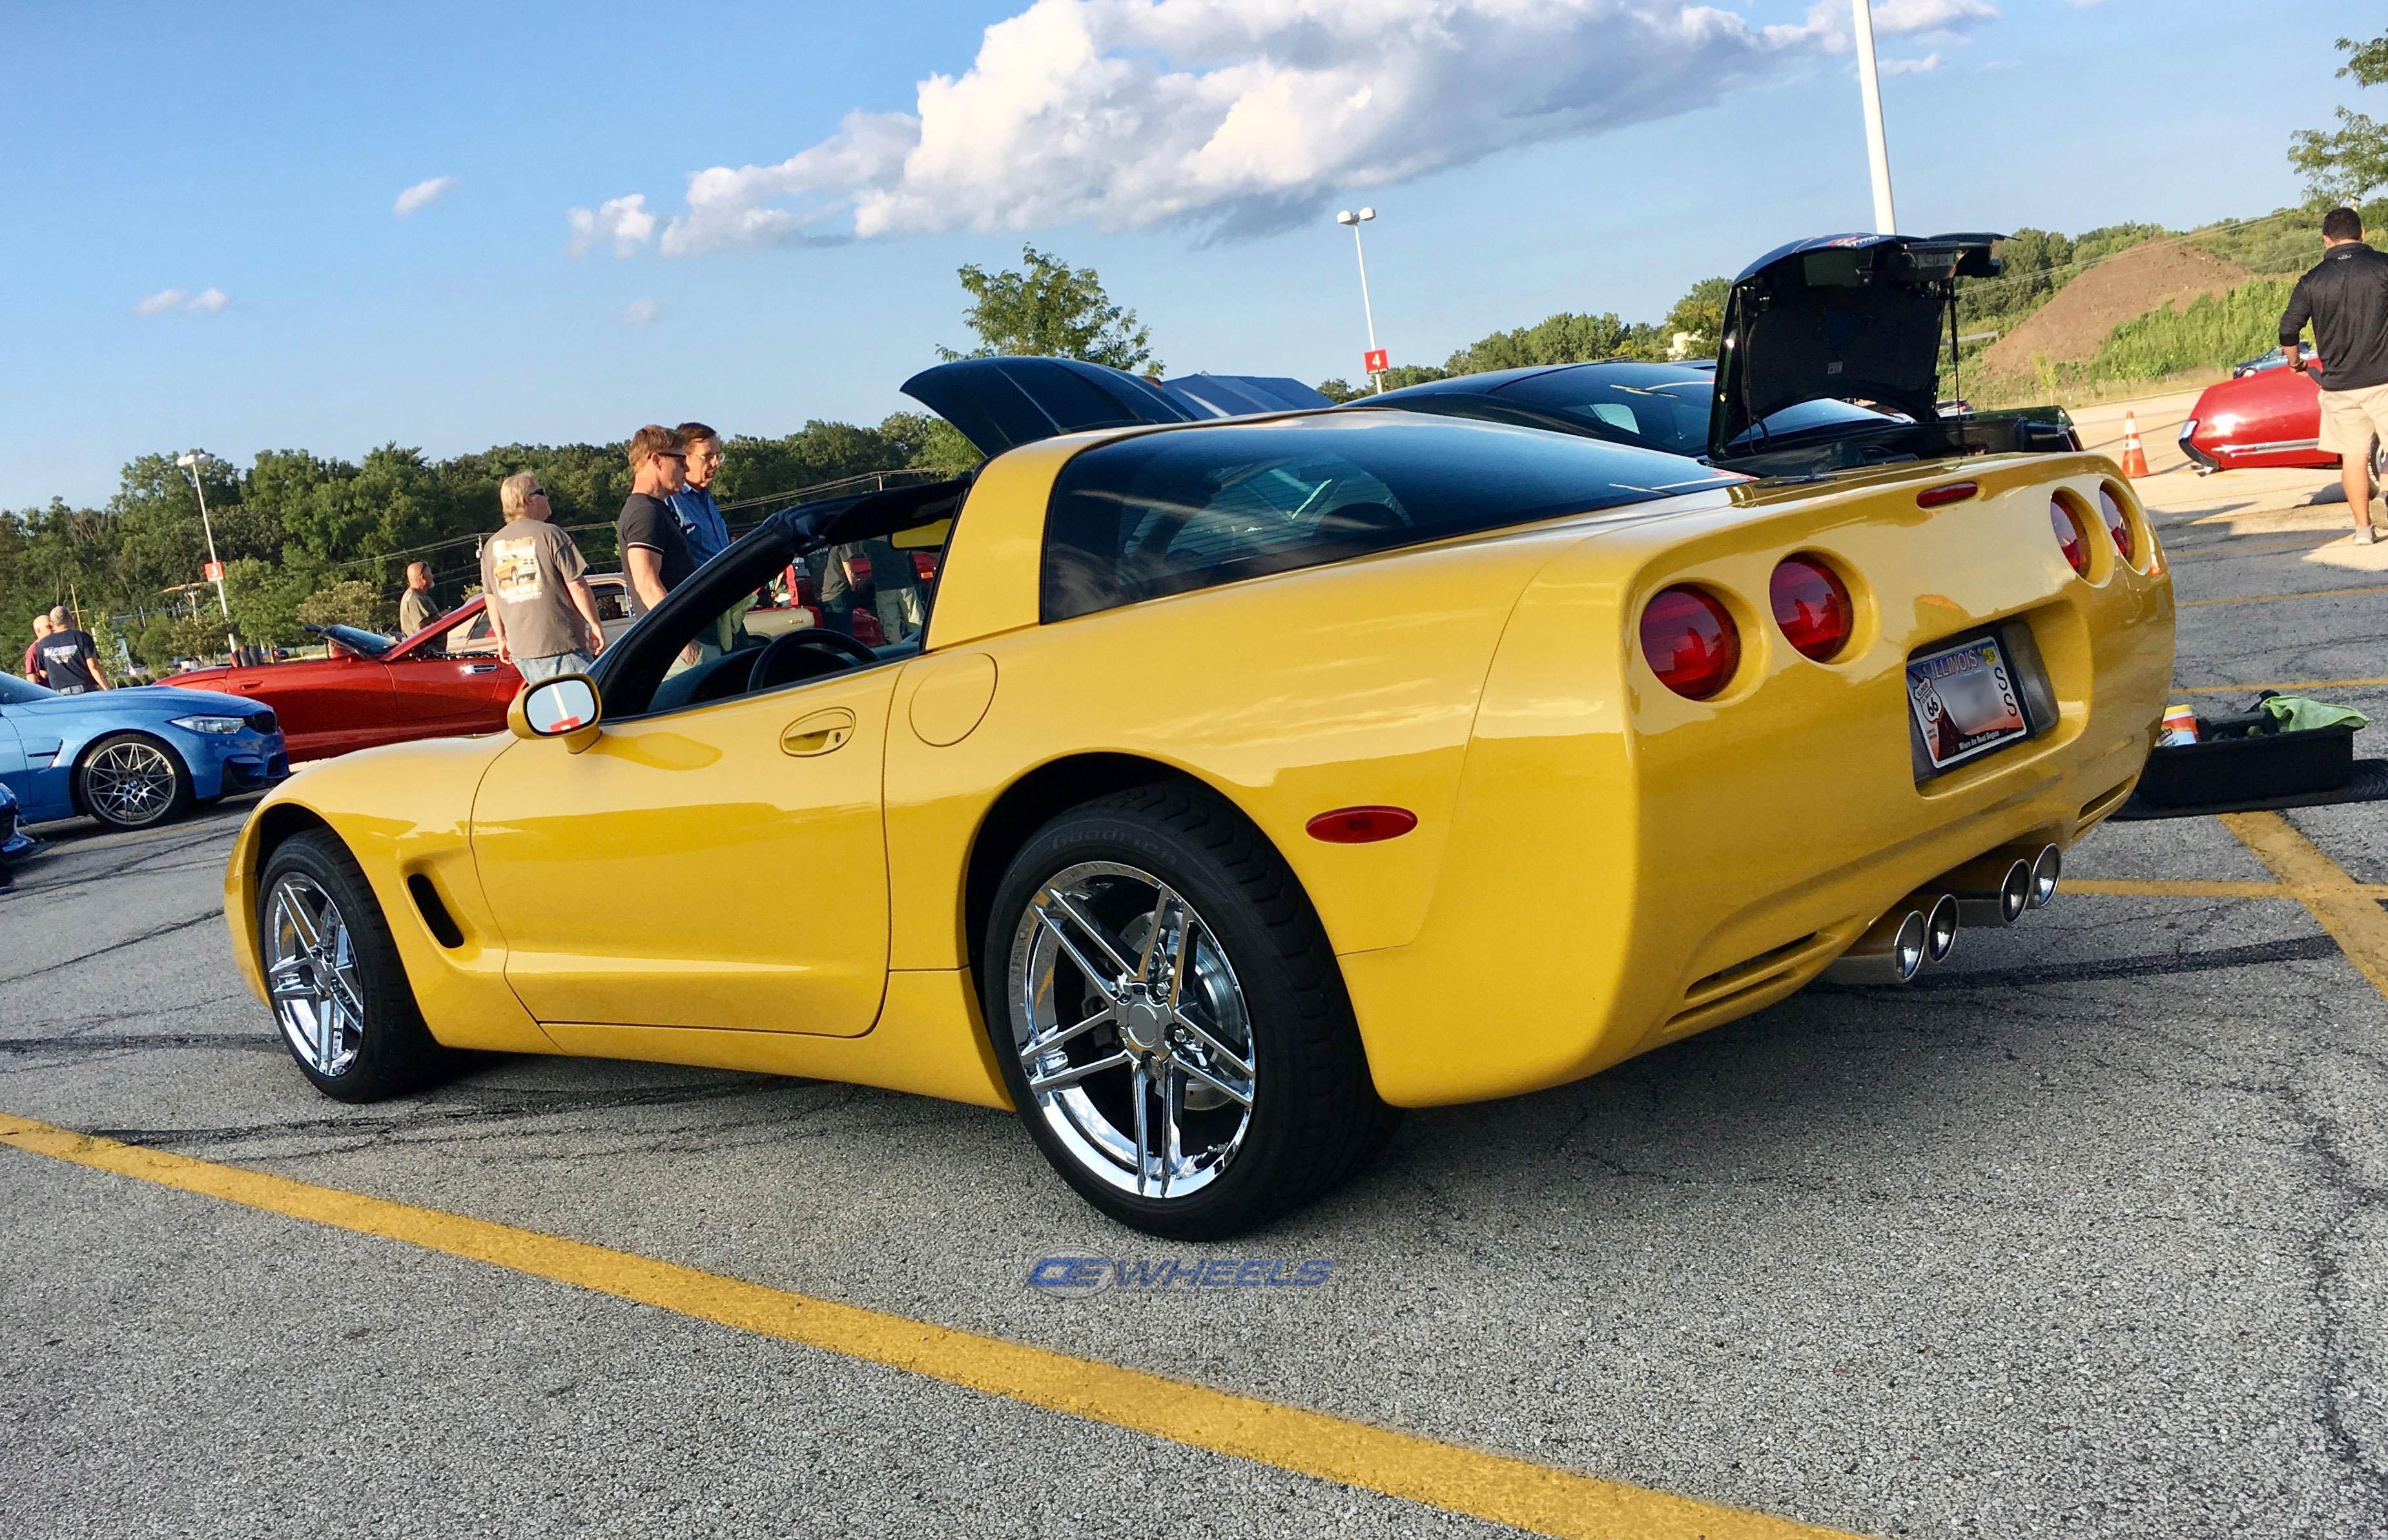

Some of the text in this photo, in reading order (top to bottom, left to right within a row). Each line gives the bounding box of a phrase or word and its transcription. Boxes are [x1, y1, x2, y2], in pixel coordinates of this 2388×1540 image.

[1372, 353, 1381, 367] 4
[211, 565, 218, 577] 3
[1931, 650, 1978, 679] ILLINOIS
[1926, 697, 1939, 717] 66
